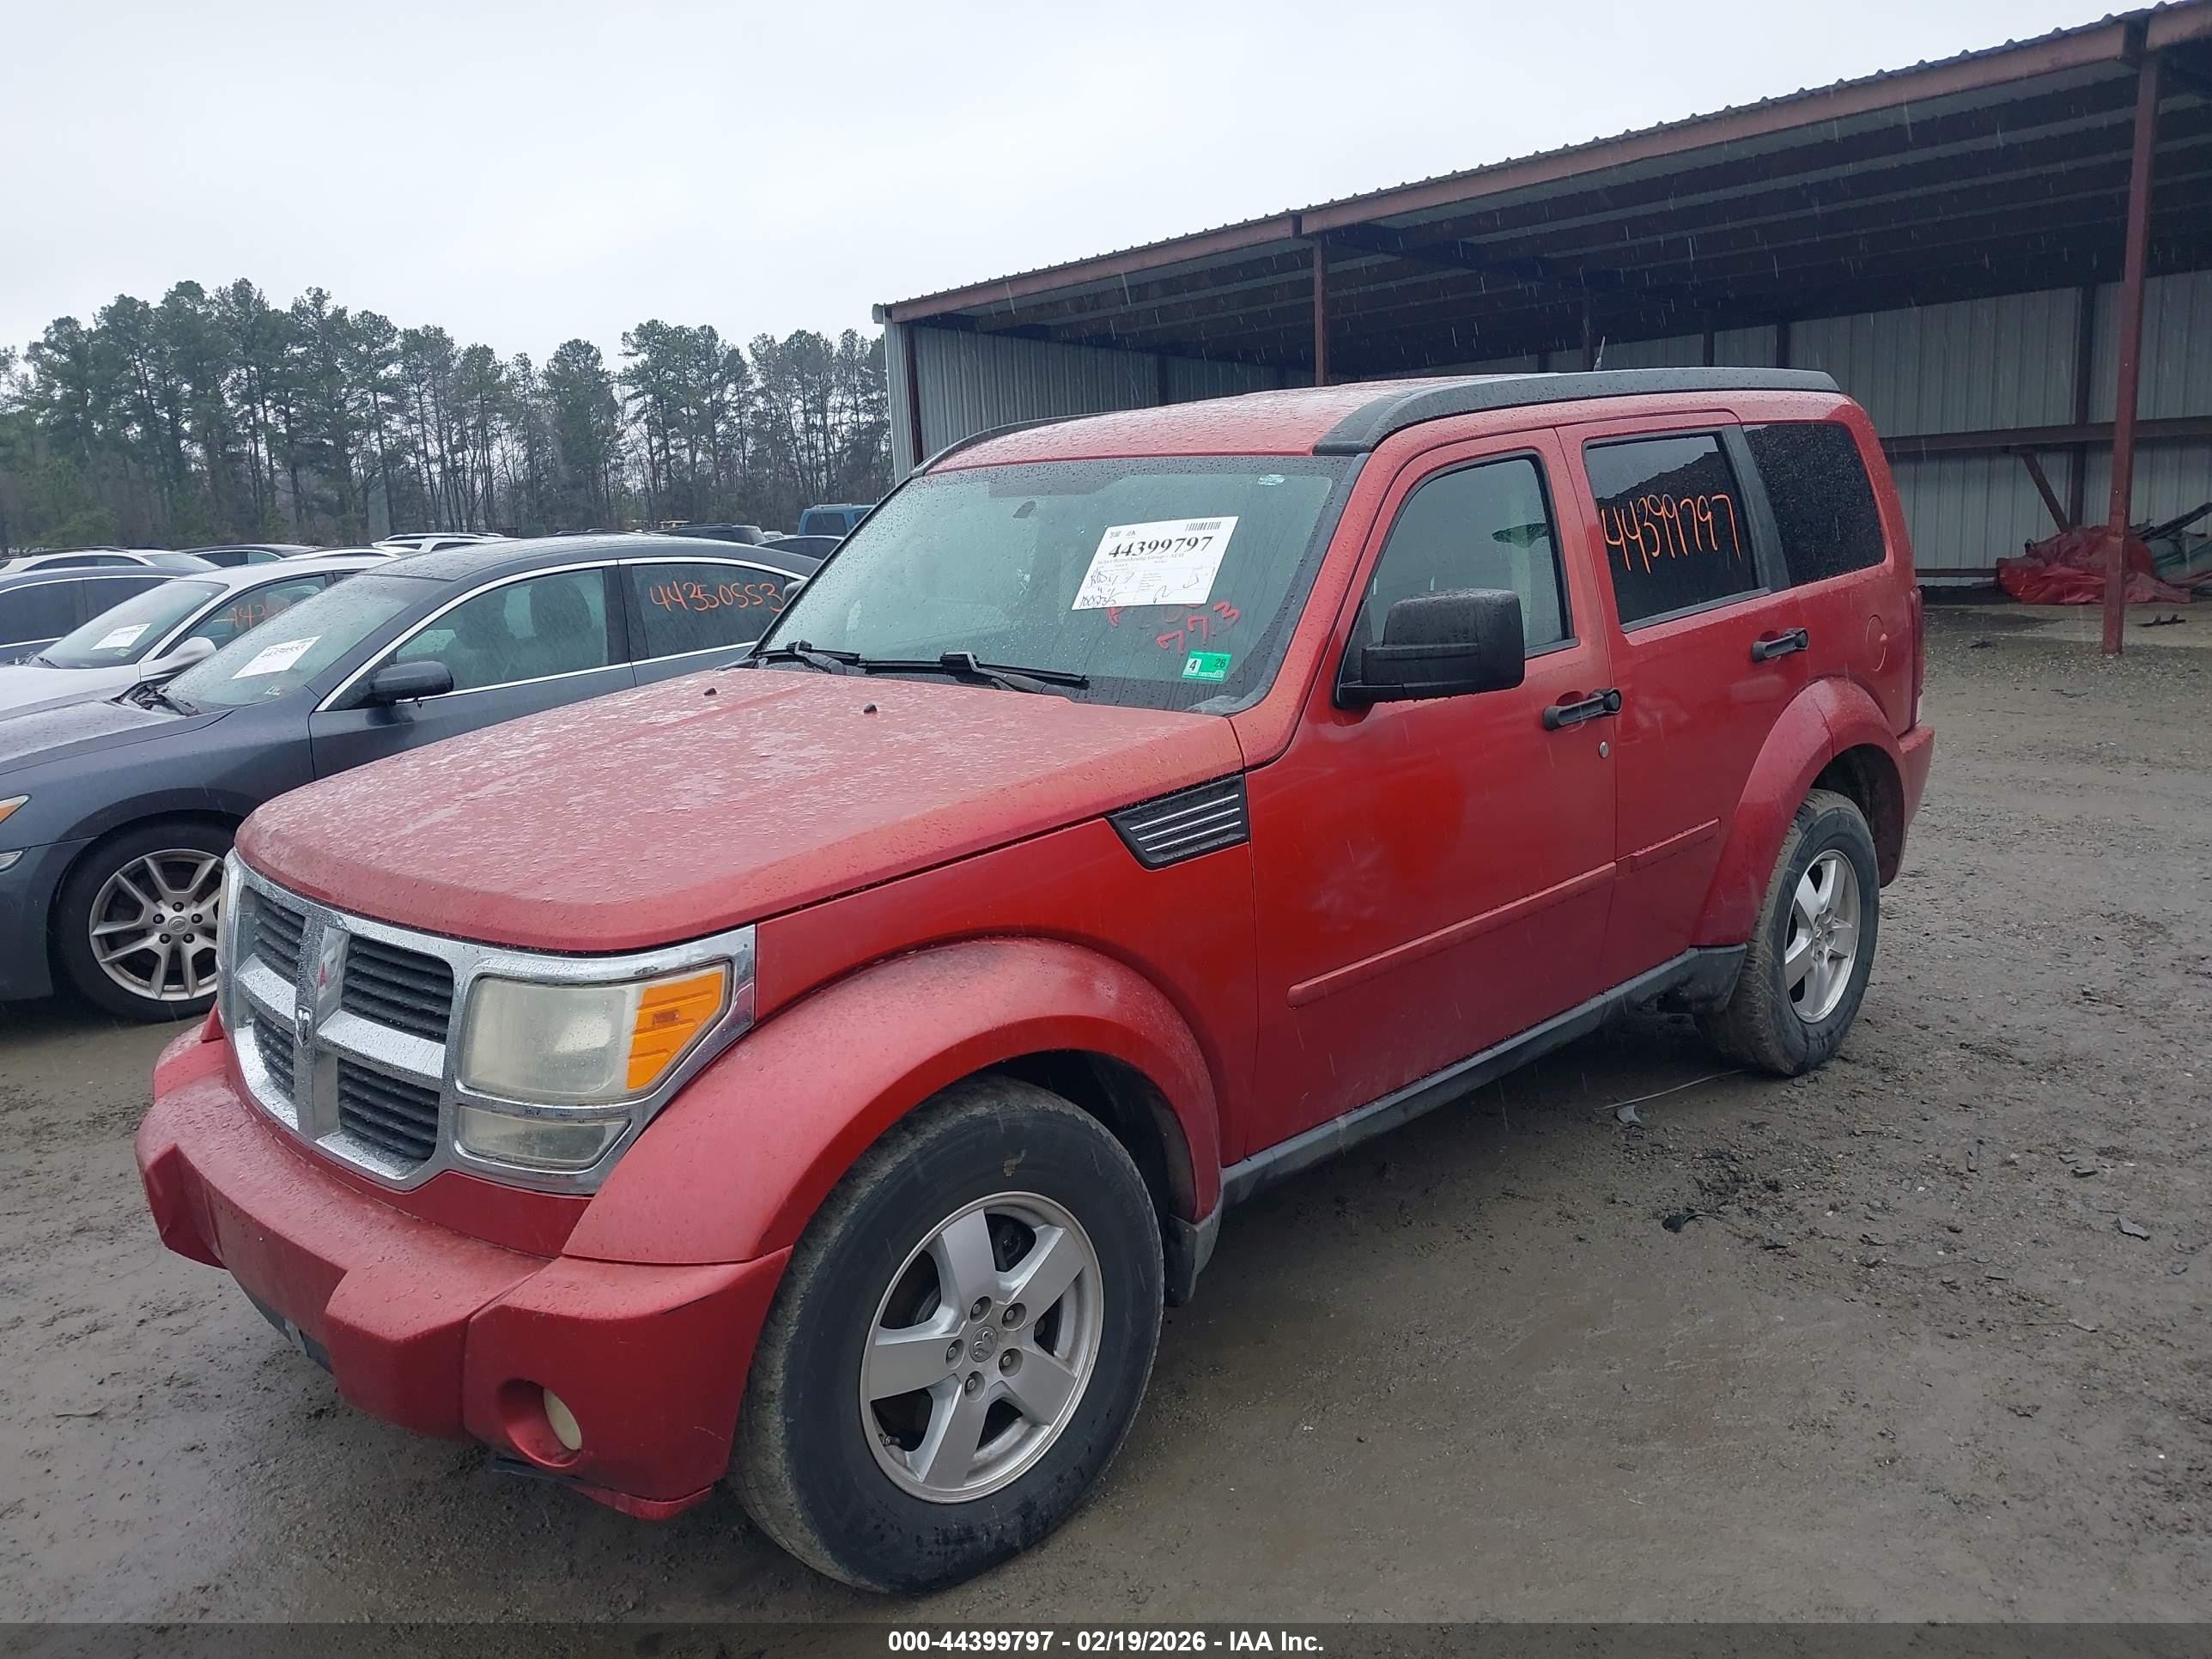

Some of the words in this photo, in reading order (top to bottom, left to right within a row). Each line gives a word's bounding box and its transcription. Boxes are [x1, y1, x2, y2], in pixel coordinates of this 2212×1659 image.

[1109, 536, 1213, 558] 44399797
[1601, 494, 1741, 575] 44399797
[649, 580, 785, 612] 44350553
[1189, 659, 1198, 671] 4
[1214, 658, 1227, 668] 26
